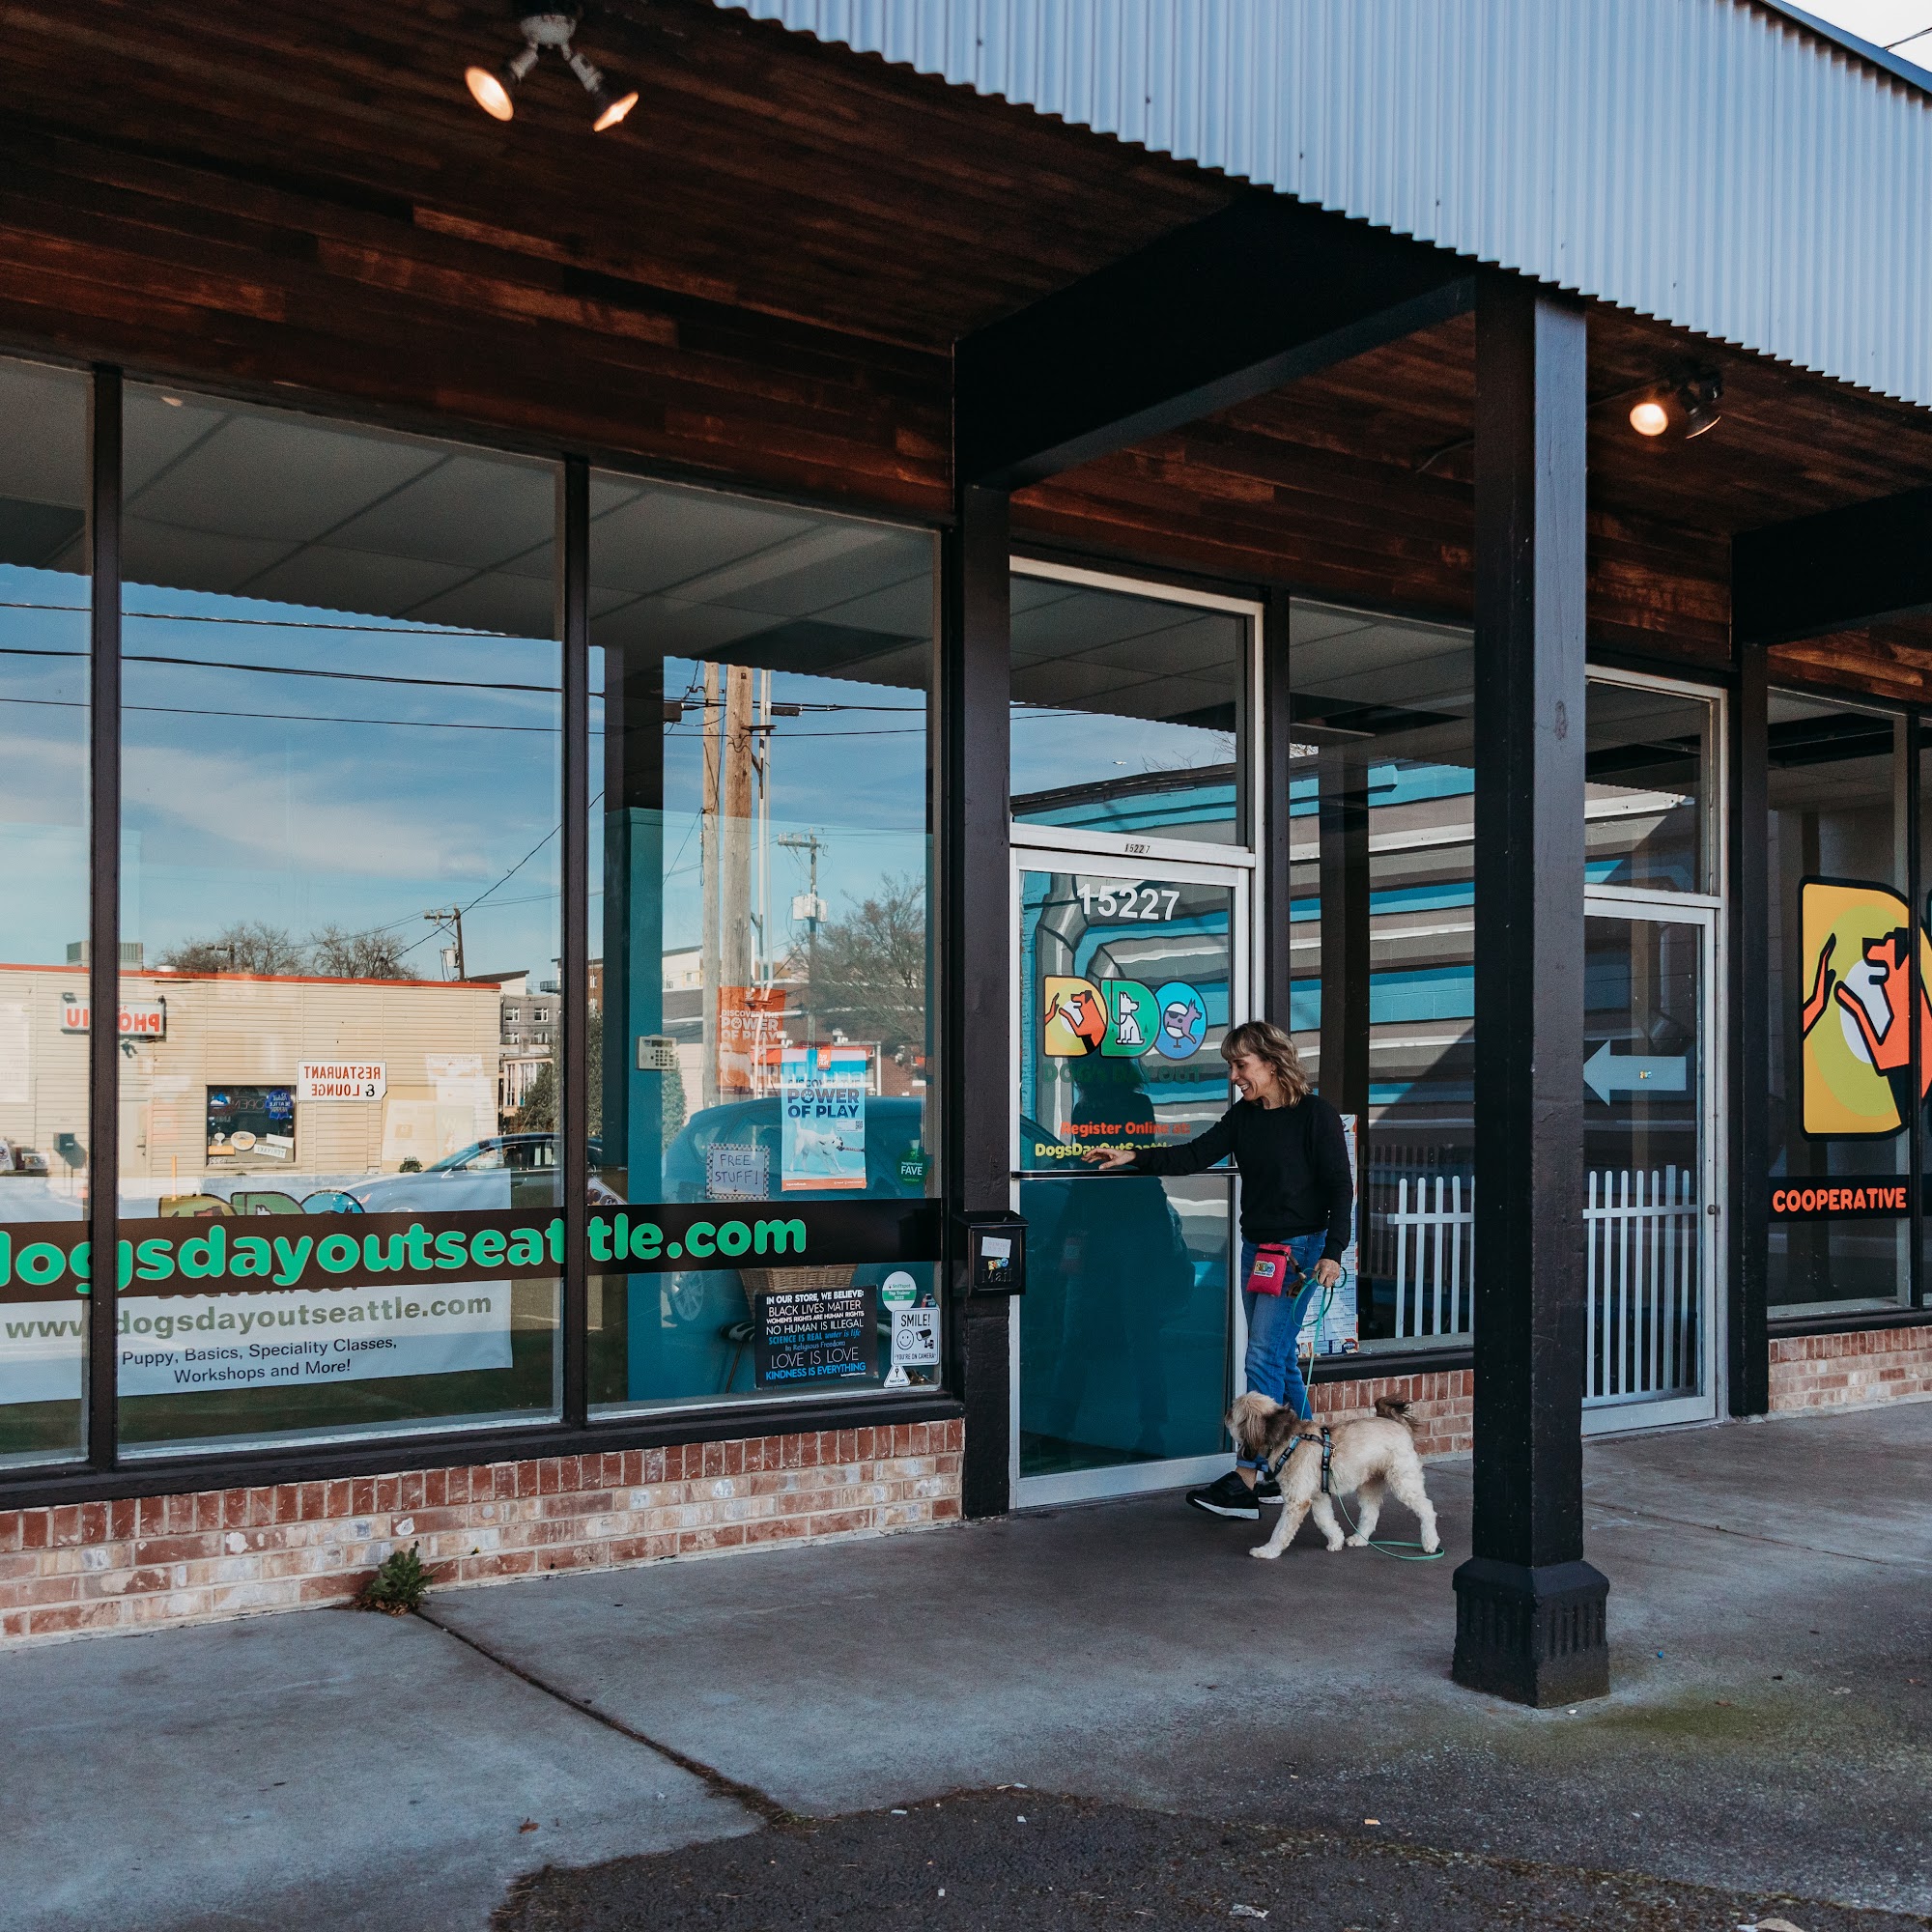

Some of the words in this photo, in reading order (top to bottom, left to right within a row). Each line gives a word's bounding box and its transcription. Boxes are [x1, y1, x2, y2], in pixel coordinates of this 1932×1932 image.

[1124, 842, 1151, 854] 15227
[1077, 883, 1179, 921] 15227
[721, 1017, 779, 1032] POWER
[721, 1030, 740, 1040] OF
[787, 1088, 860, 1104] POWER
[787, 1105, 811, 1119] OF
[815, 1105, 860, 1119] PLAY
[1060, 1121, 1122, 1138] Register
[1124, 1121, 1170, 1135] Online
[1172, 1122, 1191, 1135] at:
[720, 1153, 752, 1167] FREE
[715, 1170, 758, 1185] STUFF!
[900, 1165, 923, 1176] FAVE
[1772, 1187, 1907, 1213] COOPERATIVE
[766, 1296, 775, 1305] IN
[776, 1294, 792, 1304] OUR
[795, 1293, 819, 1303] STORE,
[821, 1292, 833, 1300] WE
[834, 1289, 865, 1300] BELIEVE:
[769, 1305, 799, 1317] BLACK
[802, 1302, 825, 1314] LIVES
[827, 1299, 862, 1312] MATTER
[766, 1325, 781, 1335] NO
[784, 1322, 817, 1334] HUMAN
[820, 1321, 828, 1330] IS
[830, 1318, 865, 1330] ILLEGAL
[900, 1313, 931, 1327] SMILE!
[768, 1334, 797, 1345] SCIENCE
[798, 1333, 806, 1343] IS
[807, 1332, 823, 1341] REAL
[843, 1329, 849, 1338] is
[850, 1328, 861, 1339] life
[122, 1350, 180, 1367] Puppy,
[185, 1347, 243, 1362] Basics,
[249, 1341, 328, 1358] Speciality
[333, 1336, 397, 1352] Classes,
[792, 1342, 820, 1352] Religious
[820, 1340, 846, 1349] Freedom
[771, 1352, 805, 1369] LOVE
[810, 1350, 821, 1365] IS
[826, 1347, 859, 1364] LOVE
[174, 1365, 266, 1383] Workshops
[271, 1362, 299, 1377] and
[305, 1358, 352, 1375] More!
[765, 1367, 807, 1380] KINDNESS
[808, 1367, 816, 1376] IS
[817, 1361, 867, 1374] EVERYTHING
